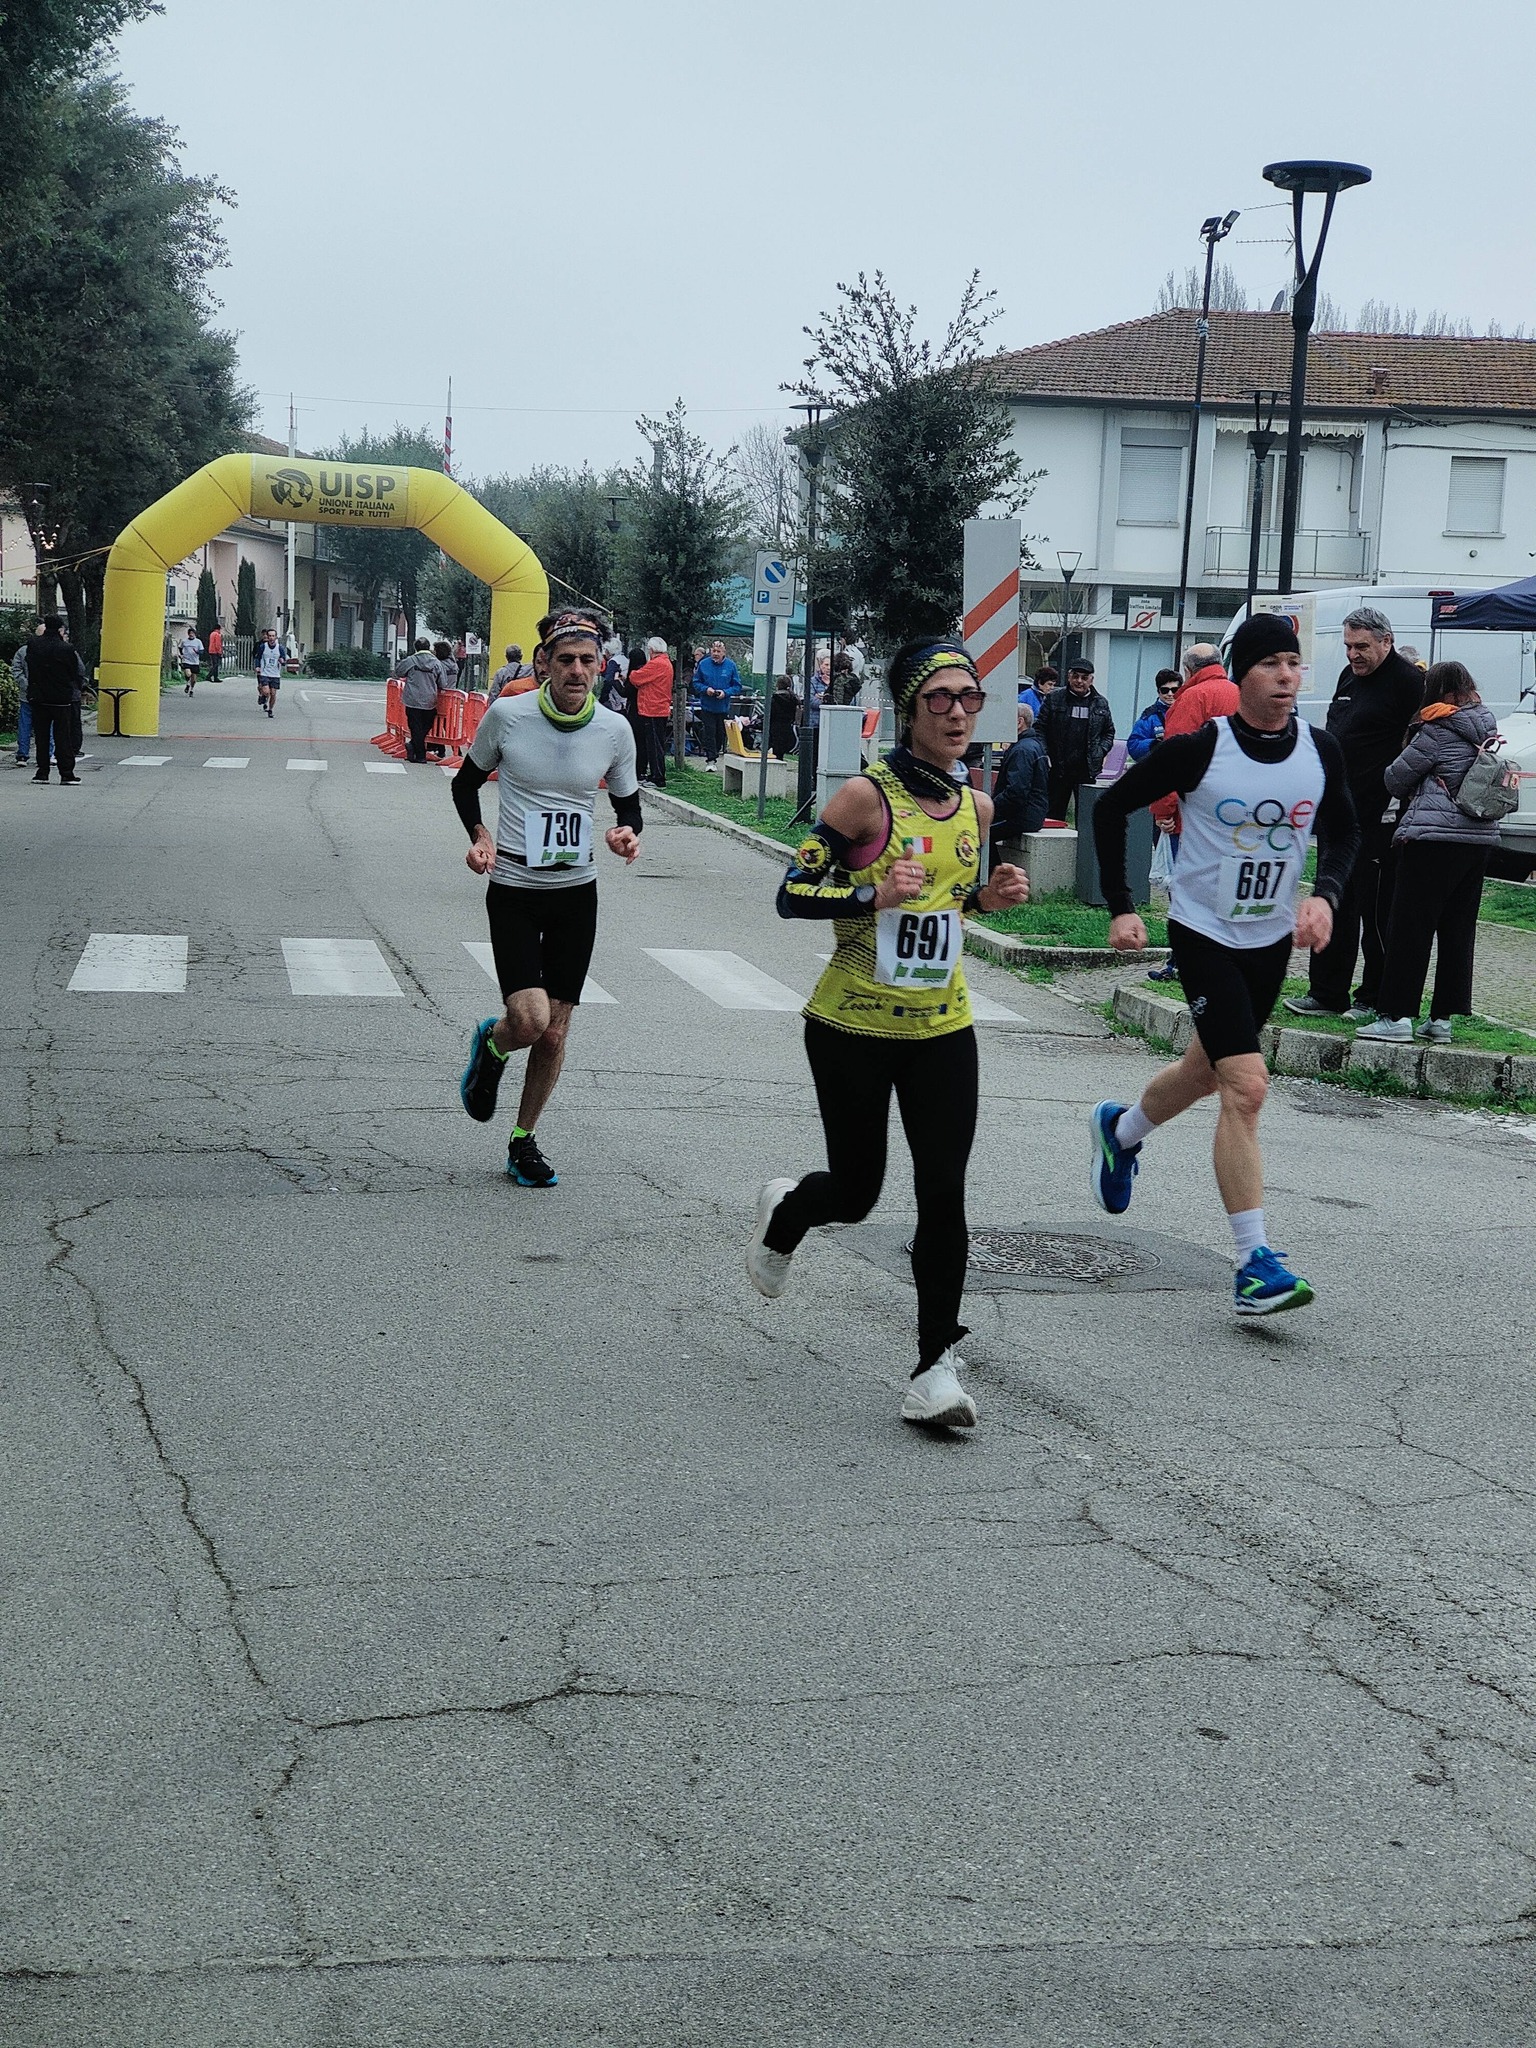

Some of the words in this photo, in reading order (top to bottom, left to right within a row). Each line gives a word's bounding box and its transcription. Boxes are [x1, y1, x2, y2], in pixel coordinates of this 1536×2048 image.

[320, 471, 395, 500] UISP
[318, 507, 346, 515] SPORT
[319, 498, 353, 508] UNIONE
[356, 501, 395, 511] ITALIANA
[541, 812, 581, 847] 730
[1236, 861, 1287, 900] 687
